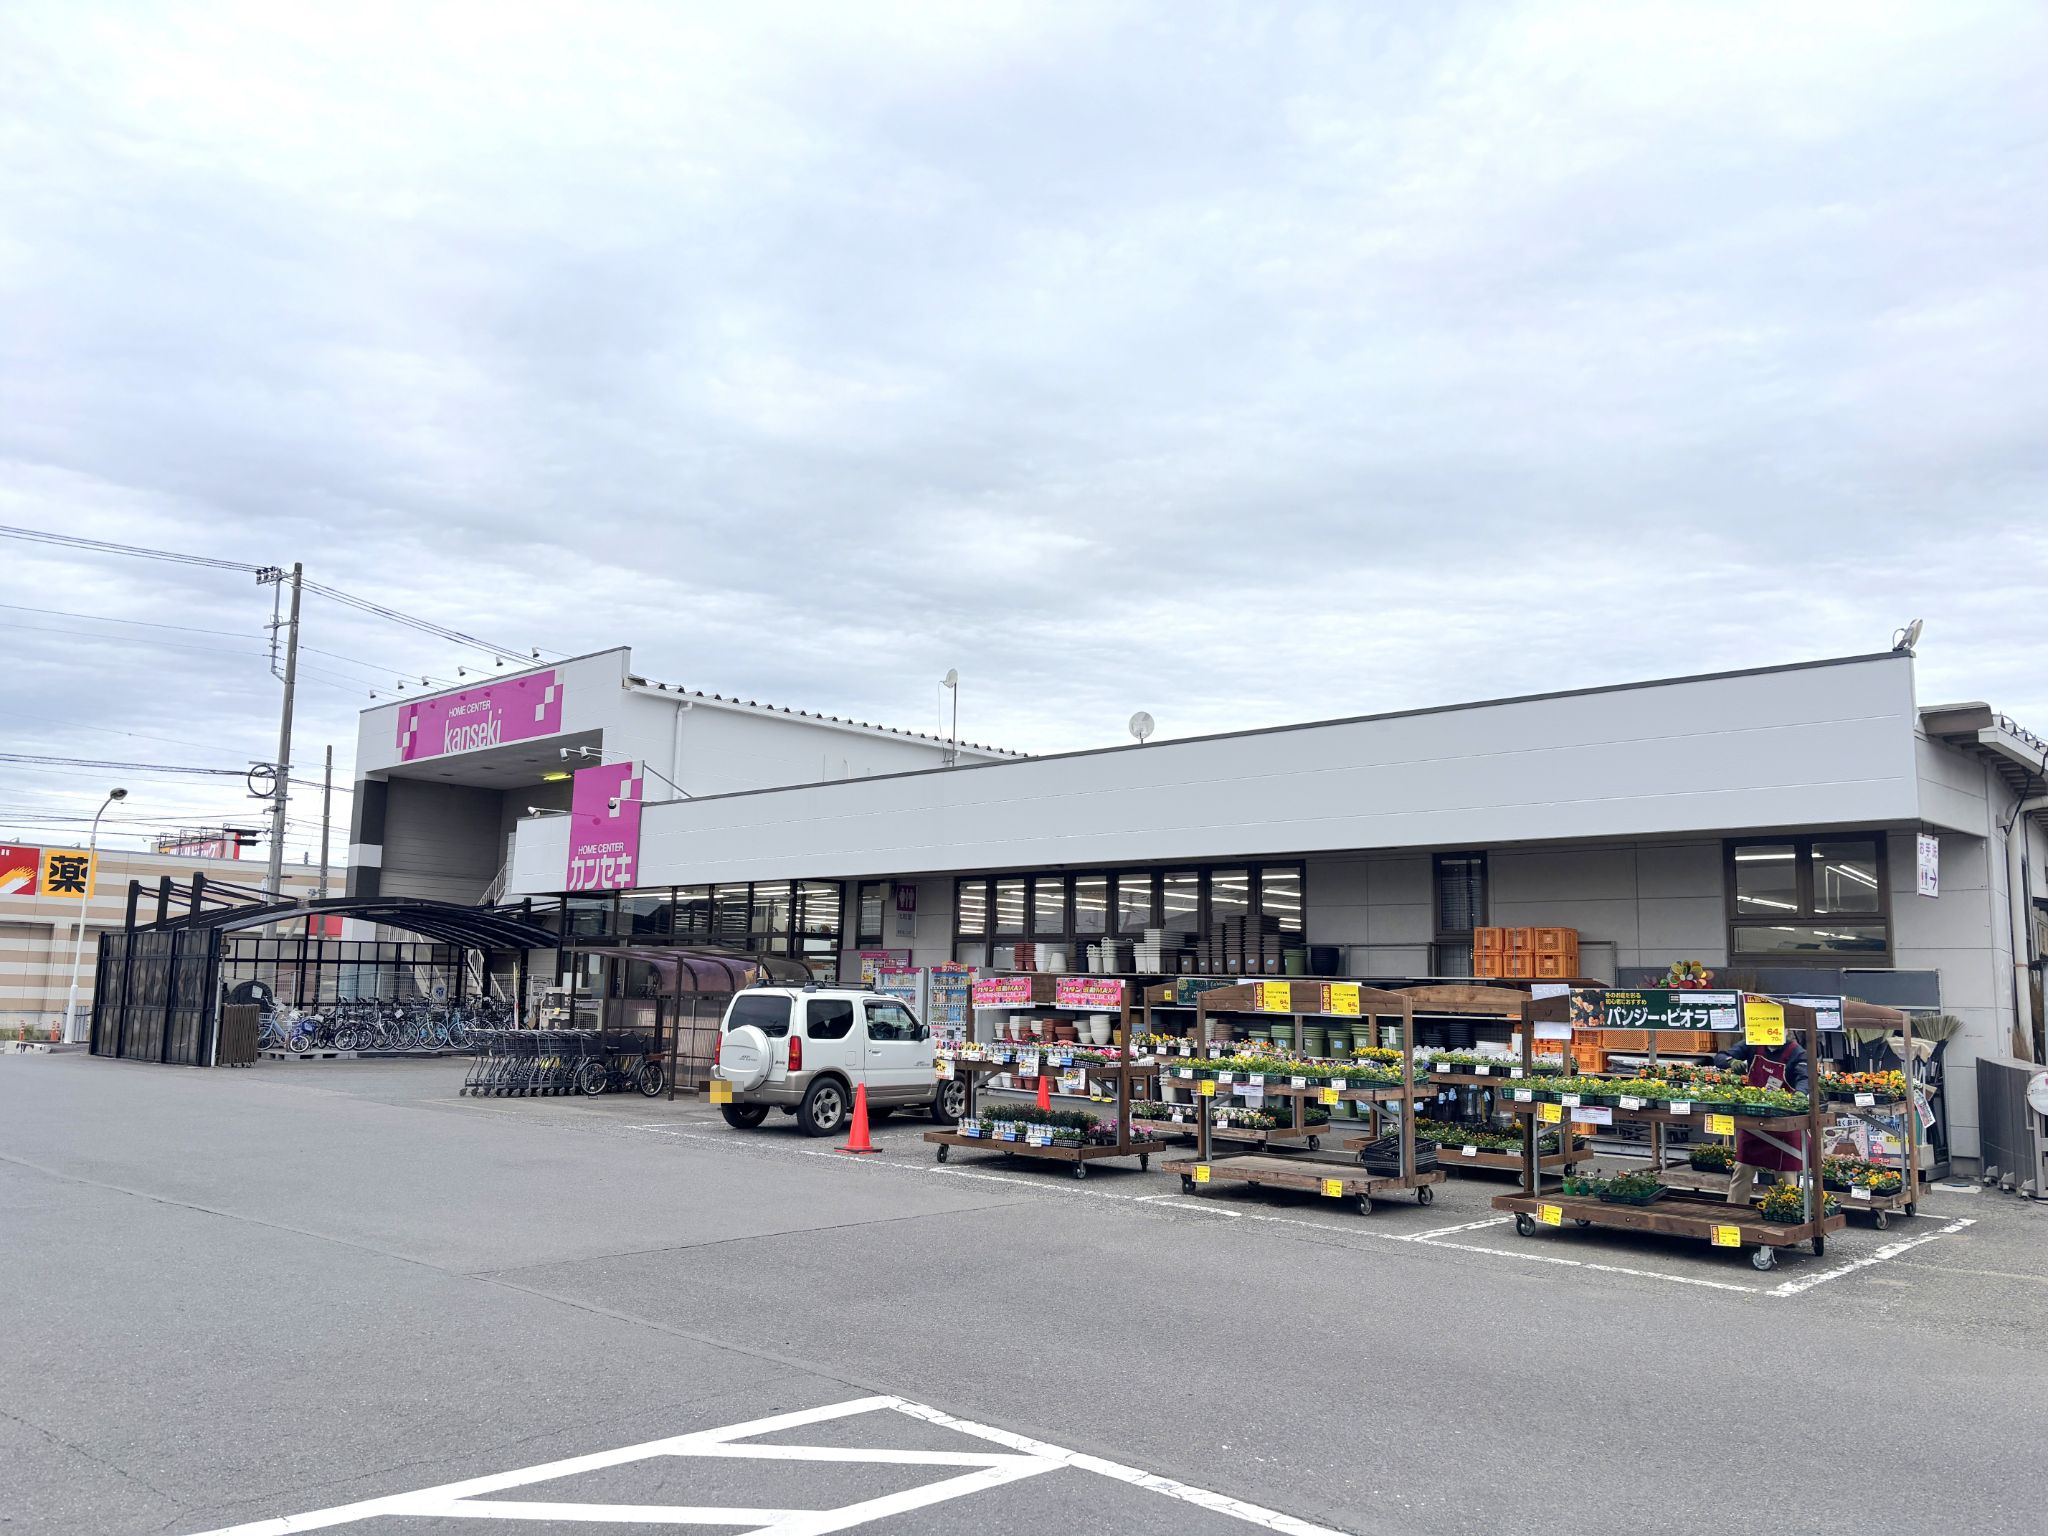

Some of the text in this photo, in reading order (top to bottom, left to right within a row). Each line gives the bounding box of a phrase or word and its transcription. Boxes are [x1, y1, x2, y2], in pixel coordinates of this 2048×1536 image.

[449, 700, 491, 717] HOME CENTER
[444, 708, 502, 754] kanseki
[578, 842, 624, 855] HOME CENTER
[48, 855, 89, 893] 薬
[569, 852, 632, 891] カンセキ
[1607, 1006, 1707, 1027] パンジー・ビオラ
